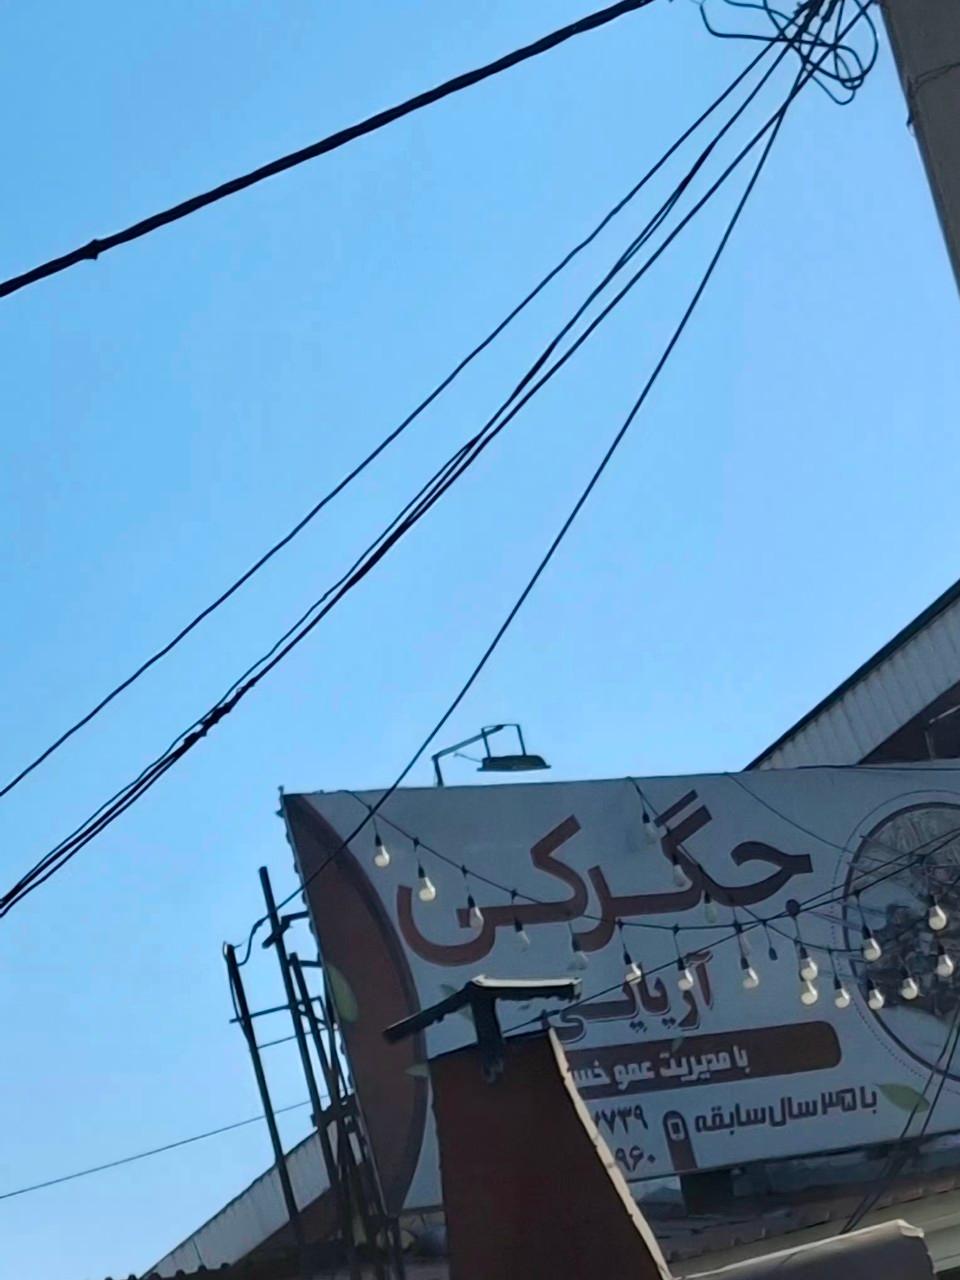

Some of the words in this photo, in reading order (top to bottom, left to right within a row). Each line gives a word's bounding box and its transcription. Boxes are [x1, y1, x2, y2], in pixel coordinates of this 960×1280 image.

[397, 789, 814, 967] جگرکی
[555, 950, 714, 1045] آریایی
[570, 1058, 611, 1088] خس
[613, 1059, 655, 1091] عمو
[659, 1046, 732, 1082] مدیریت
[734, 1044, 750, 1075] با
[768, 1096, 817, 1127] سال
[862, 1085, 878, 1115] با
[694, 1103, 768, 1136] سابقه
[614, 1144, 656, 1172] ۹۶۰
